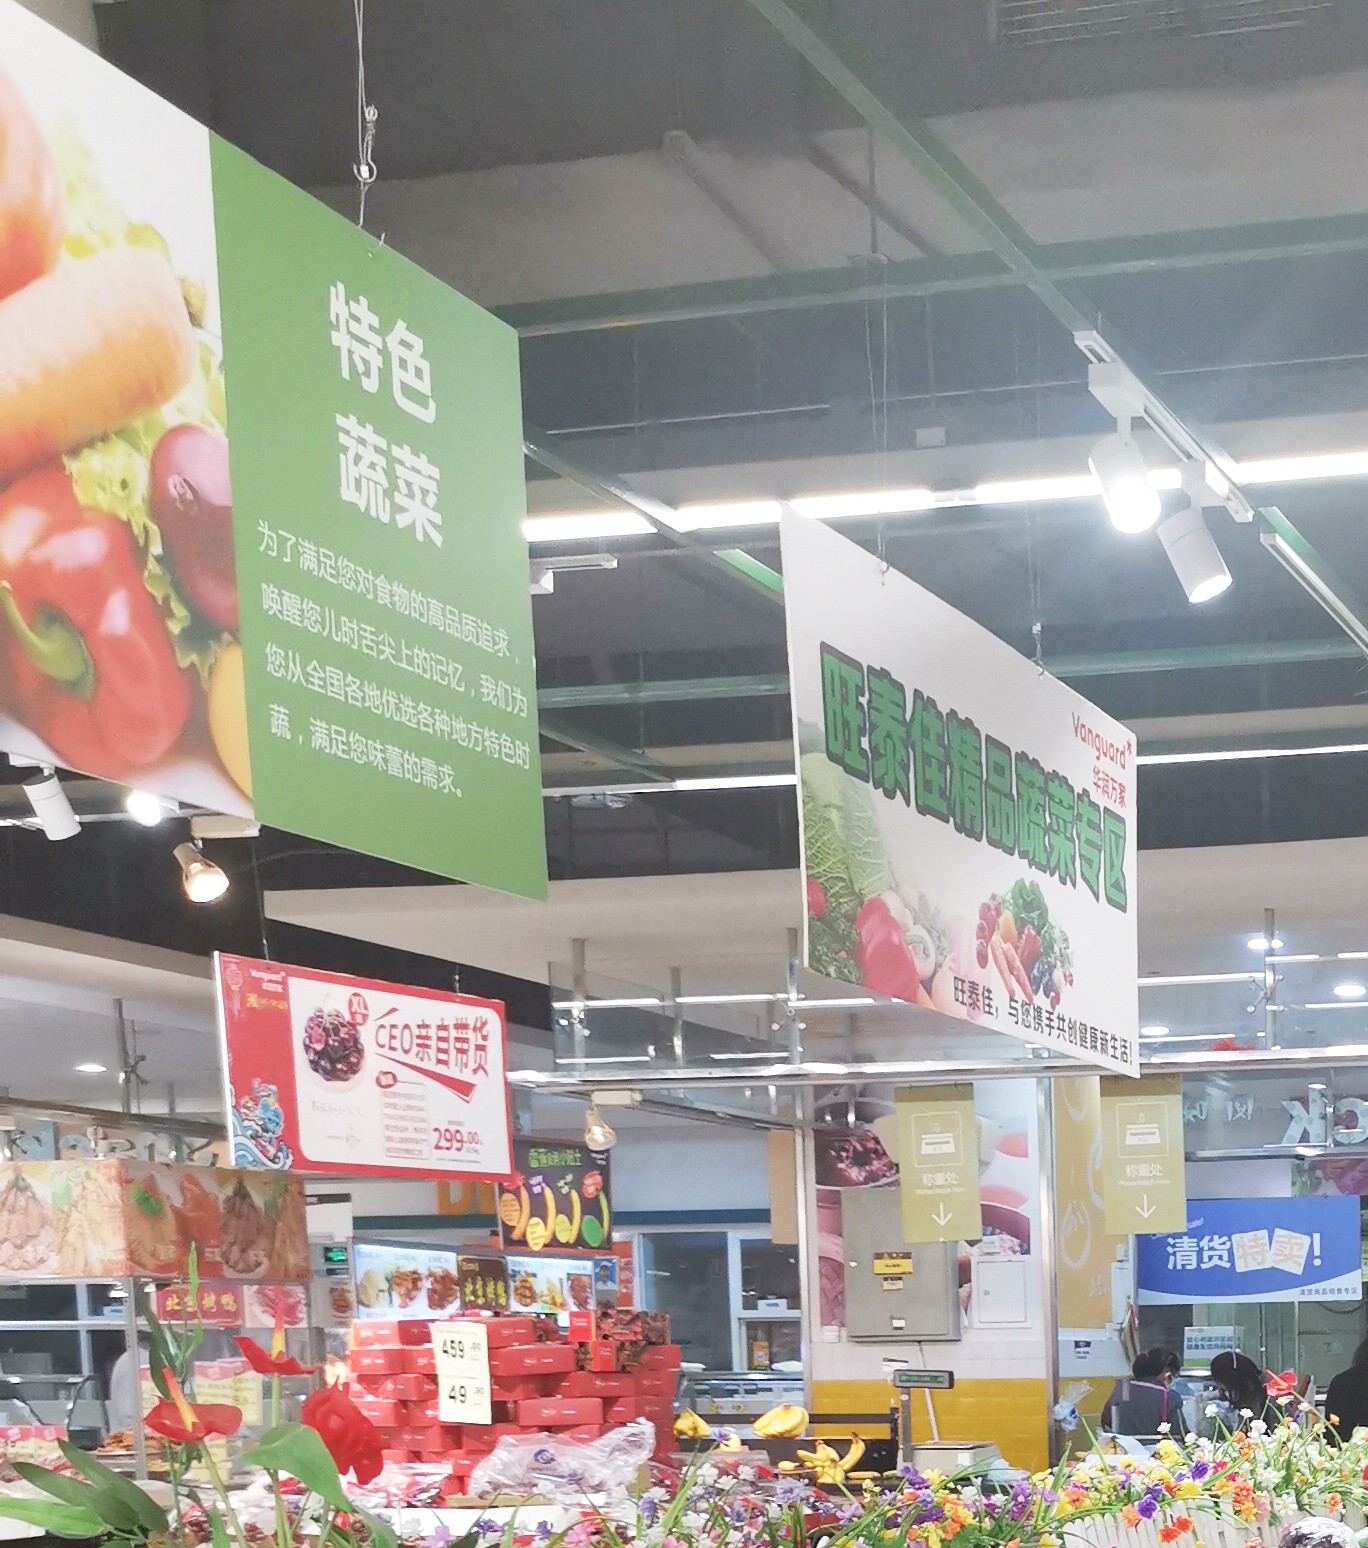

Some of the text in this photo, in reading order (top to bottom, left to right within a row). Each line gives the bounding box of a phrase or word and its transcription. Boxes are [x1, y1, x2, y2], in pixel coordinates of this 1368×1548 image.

[329, 282, 437, 424] 特色
[336, 414, 444, 549] 蔬菜
[1071, 711, 1126, 770] Vanguard
[820, 640, 1127, 914] 旺泰佳精品蔬菜专区
[375, 1014, 489, 1079] CEO亲自带货
[442, 1339, 465, 1359] 459
[449, 1385, 467, 1404] 49
